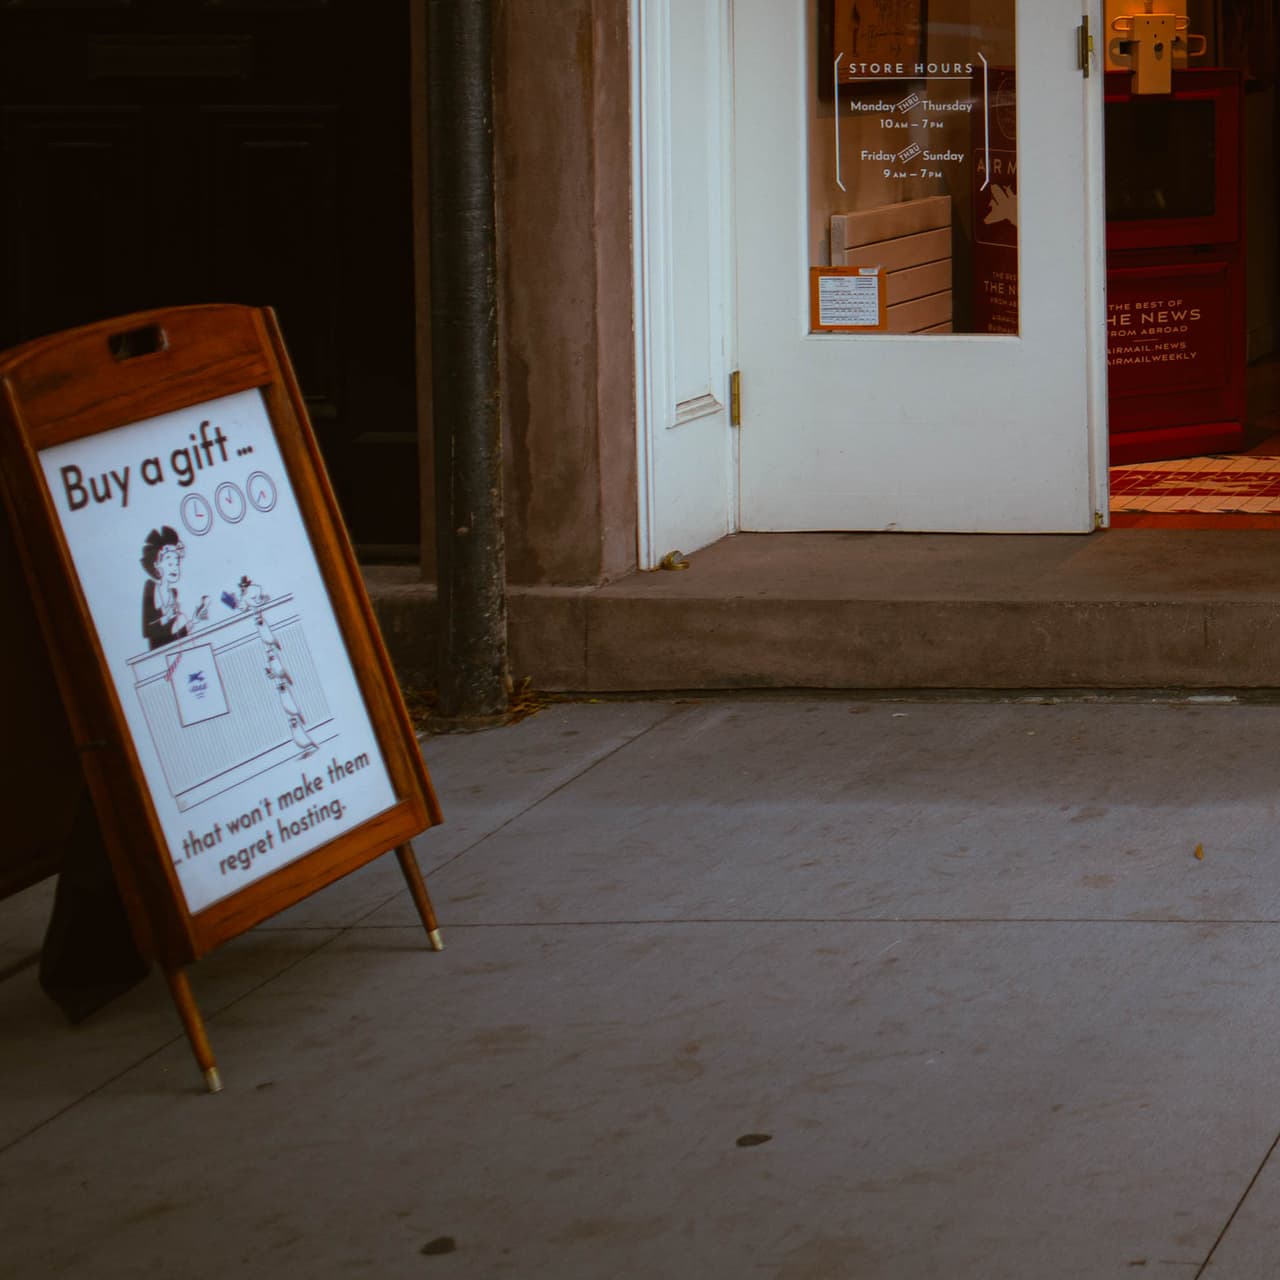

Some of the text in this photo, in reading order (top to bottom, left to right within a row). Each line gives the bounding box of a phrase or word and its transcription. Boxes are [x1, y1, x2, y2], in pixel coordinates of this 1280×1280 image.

[848, 62, 974, 74] STORE HOURS
[850, 94, 973, 114] Monday THRU Thursday
[861, 144, 964, 164] Friday THRU Sunday
[1108, 299, 1183, 311] THE BEST OF
[1107, 308, 1201, 326] HE NEWS
[1109, 325, 1188, 337] ROM ABROAD
[60, 464, 130, 512] Buy
[140, 457, 164, 486] a
[225, 796, 272, 836] won't
[277, 772, 323, 811] make
[327, 751, 370, 785] them
[218, 798, 347, 876] regret hosting.
